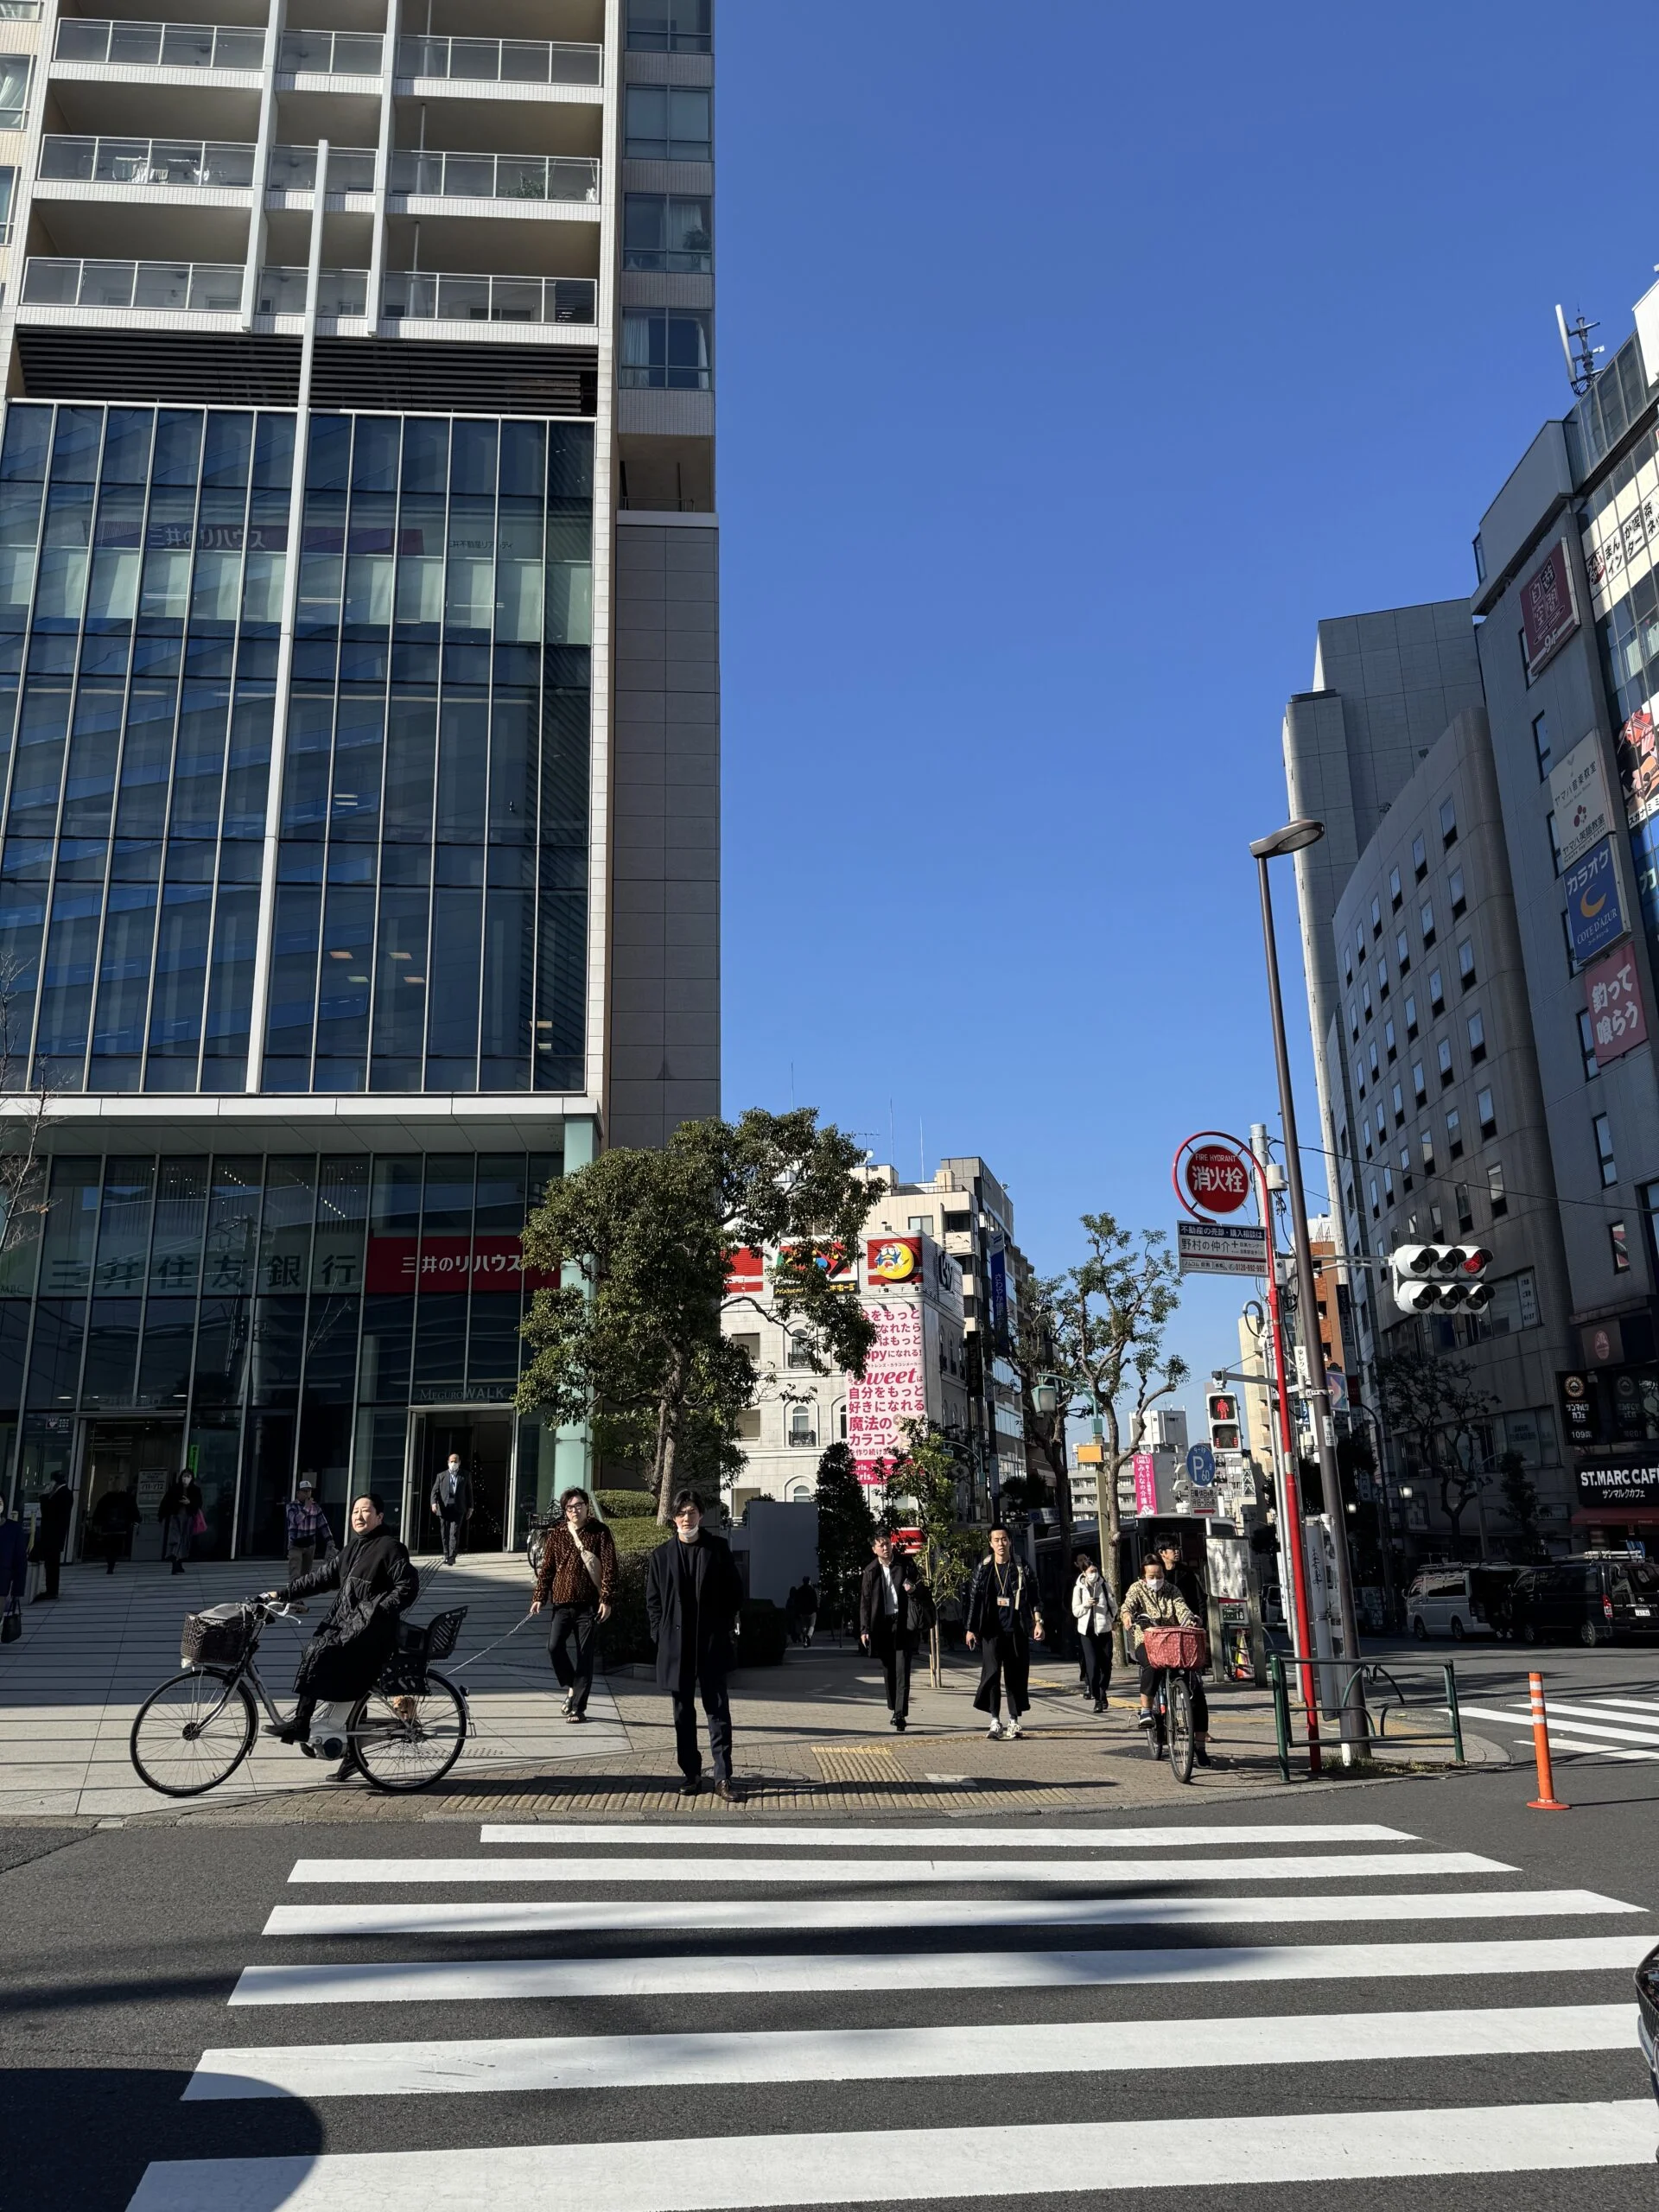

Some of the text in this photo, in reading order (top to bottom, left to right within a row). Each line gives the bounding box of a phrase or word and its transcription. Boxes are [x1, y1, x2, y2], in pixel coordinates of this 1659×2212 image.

[448, 540, 513, 550] 三井不動産リアティ
[1554, 760, 1597, 806] ヤマハ音楽教室
[1562, 812, 1605, 855] ヤマハ英語教室
[1567, 848, 1609, 896] カラオケ
[1592, 963, 1633, 1014] 釣って
[1596, 1001, 1638, 1046] 喰らう
[1195, 1154, 1236, 1163] FIRE HYDRANT
[1192, 1165, 1245, 1192] 消火栓
[1180, 1225, 1263, 1239] 不動産の売却・購入相談は
[48, 1254, 357, 1289] 三井住友銀行
[401, 1254, 522, 1273] 三井のリハウス
[0, 1284, 25, 1294] MBC
[879, 1335, 922, 1346] はもっと
[849, 1385, 924, 1400] 自分をもっと
[848, 1400, 925, 1414] 好きになれる
[849, 1415, 893, 1432] 魔法の
[849, 1433, 899, 1446] カラコン
[1192, 1455, 1205, 1482] P
[1201, 1469, 1211, 1482] 60
[1580, 1469, 1630, 1486] ST.MARC
[1602, 1489, 1646, 1499] サンマルクカフェ
